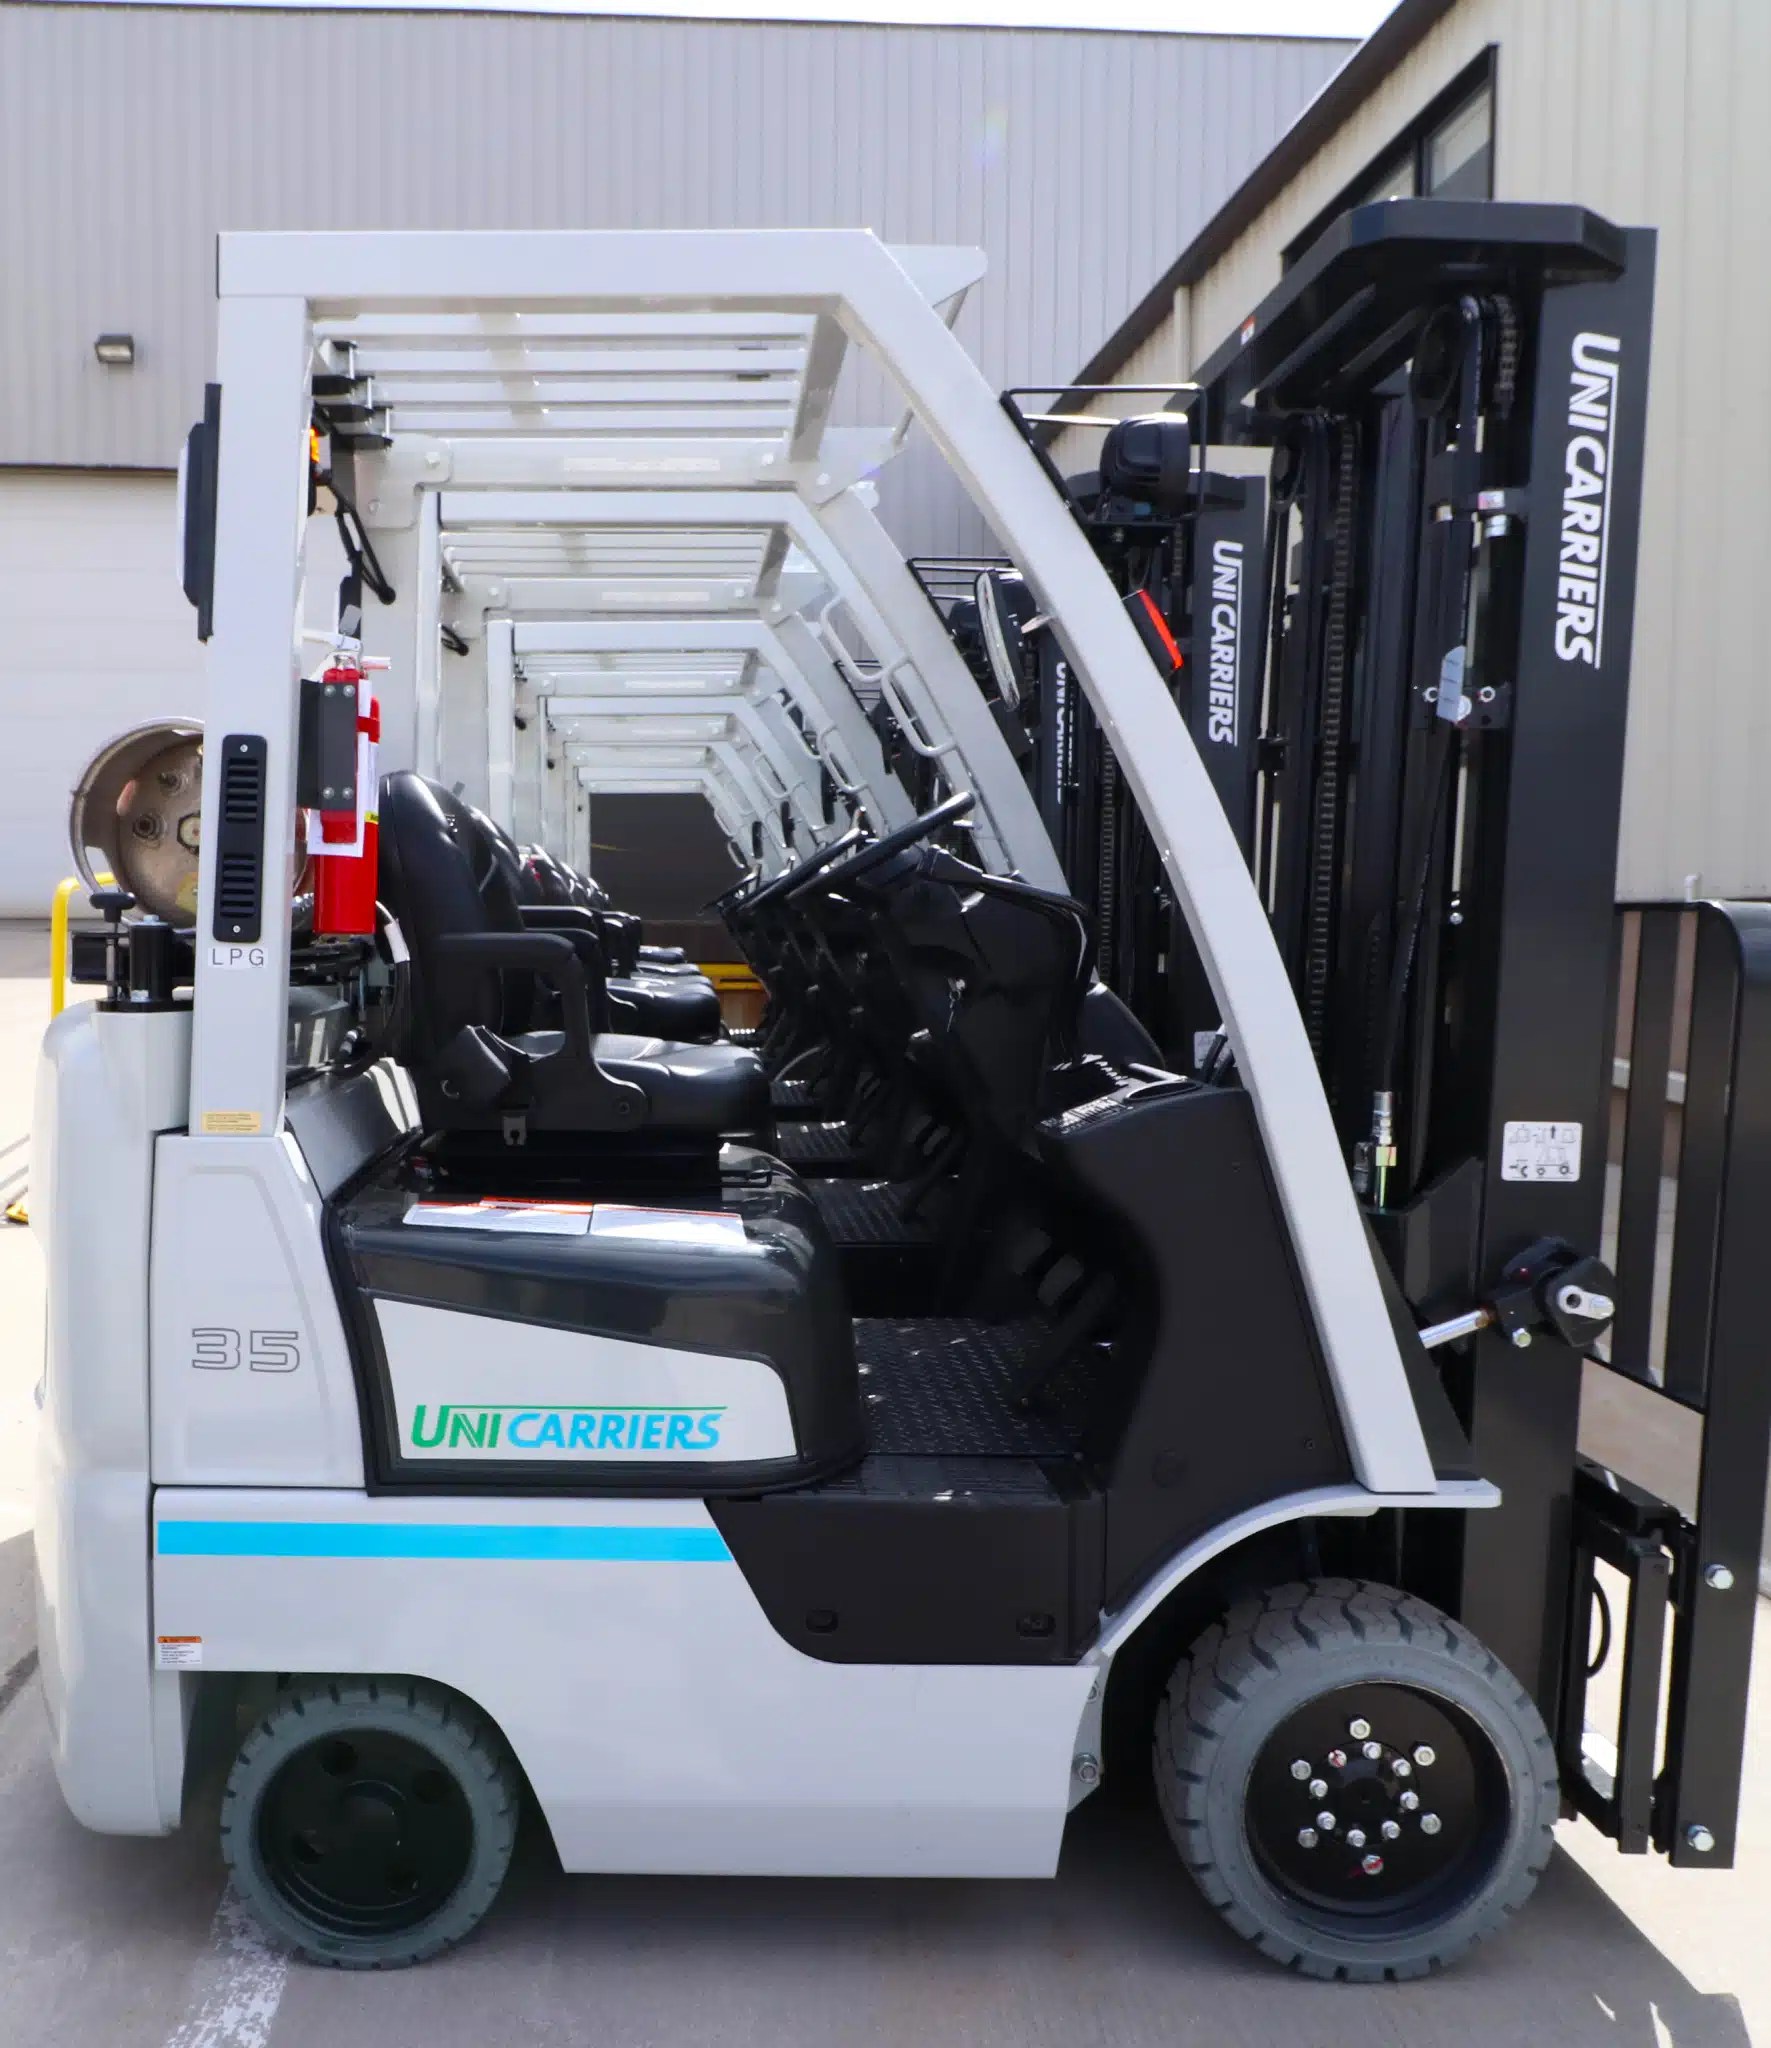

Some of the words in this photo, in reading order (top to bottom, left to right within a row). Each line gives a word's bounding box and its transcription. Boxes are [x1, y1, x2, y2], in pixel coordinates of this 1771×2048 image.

[1554, 331, 1621, 670] UNICARRIERS
[1208, 539, 1244, 747] UNICARRIERS
[212, 948, 265, 966] LPG
[191, 1327, 300, 1373] 35
[410, 1404, 728, 1450] UNICARRIERS
